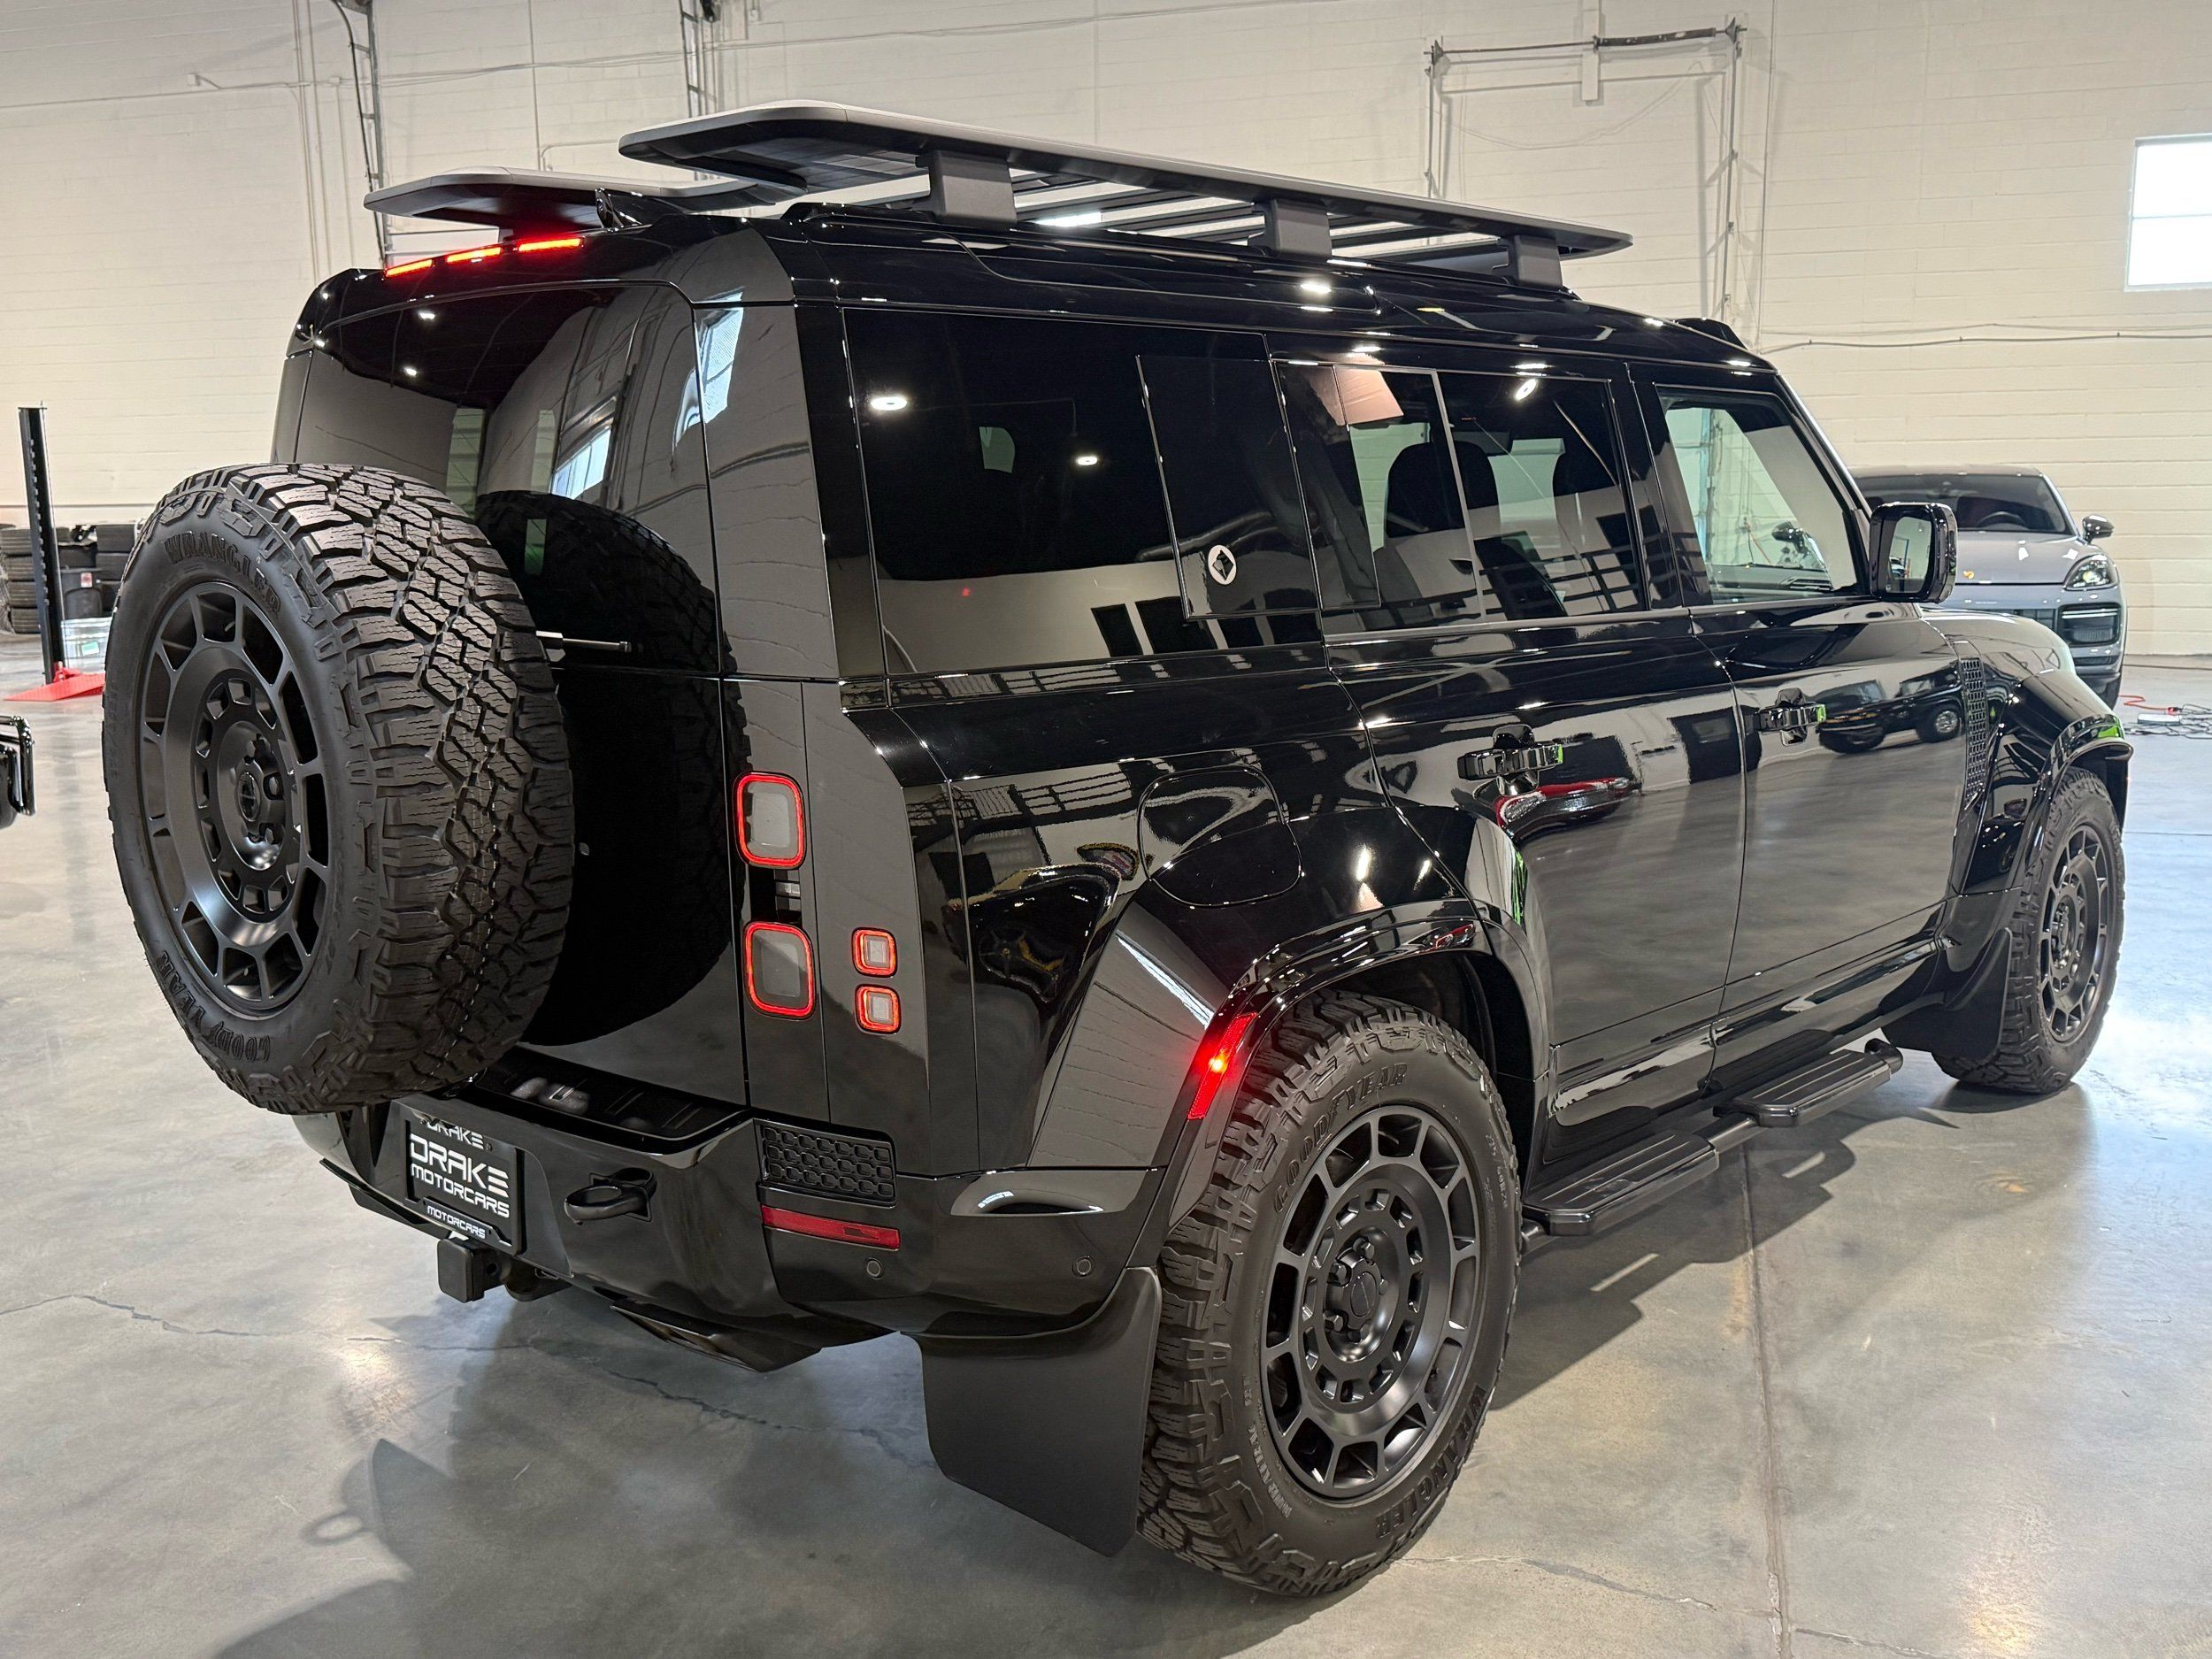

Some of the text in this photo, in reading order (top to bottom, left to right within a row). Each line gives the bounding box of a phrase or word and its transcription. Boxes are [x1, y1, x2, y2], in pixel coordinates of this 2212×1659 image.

[164, 531, 281, 614] WRANGLER
[156, 950, 271, 1063] GOODYEAR
[410, 1133, 510, 1198] DRAKE
[1274, 1062, 1409, 1213] GOODYEAR
[411, 1162, 511, 1219] MOTORCARS
[426, 1204, 486, 1240] MOTORCARS
[1375, 1382, 1487, 1540] WRANGLER
